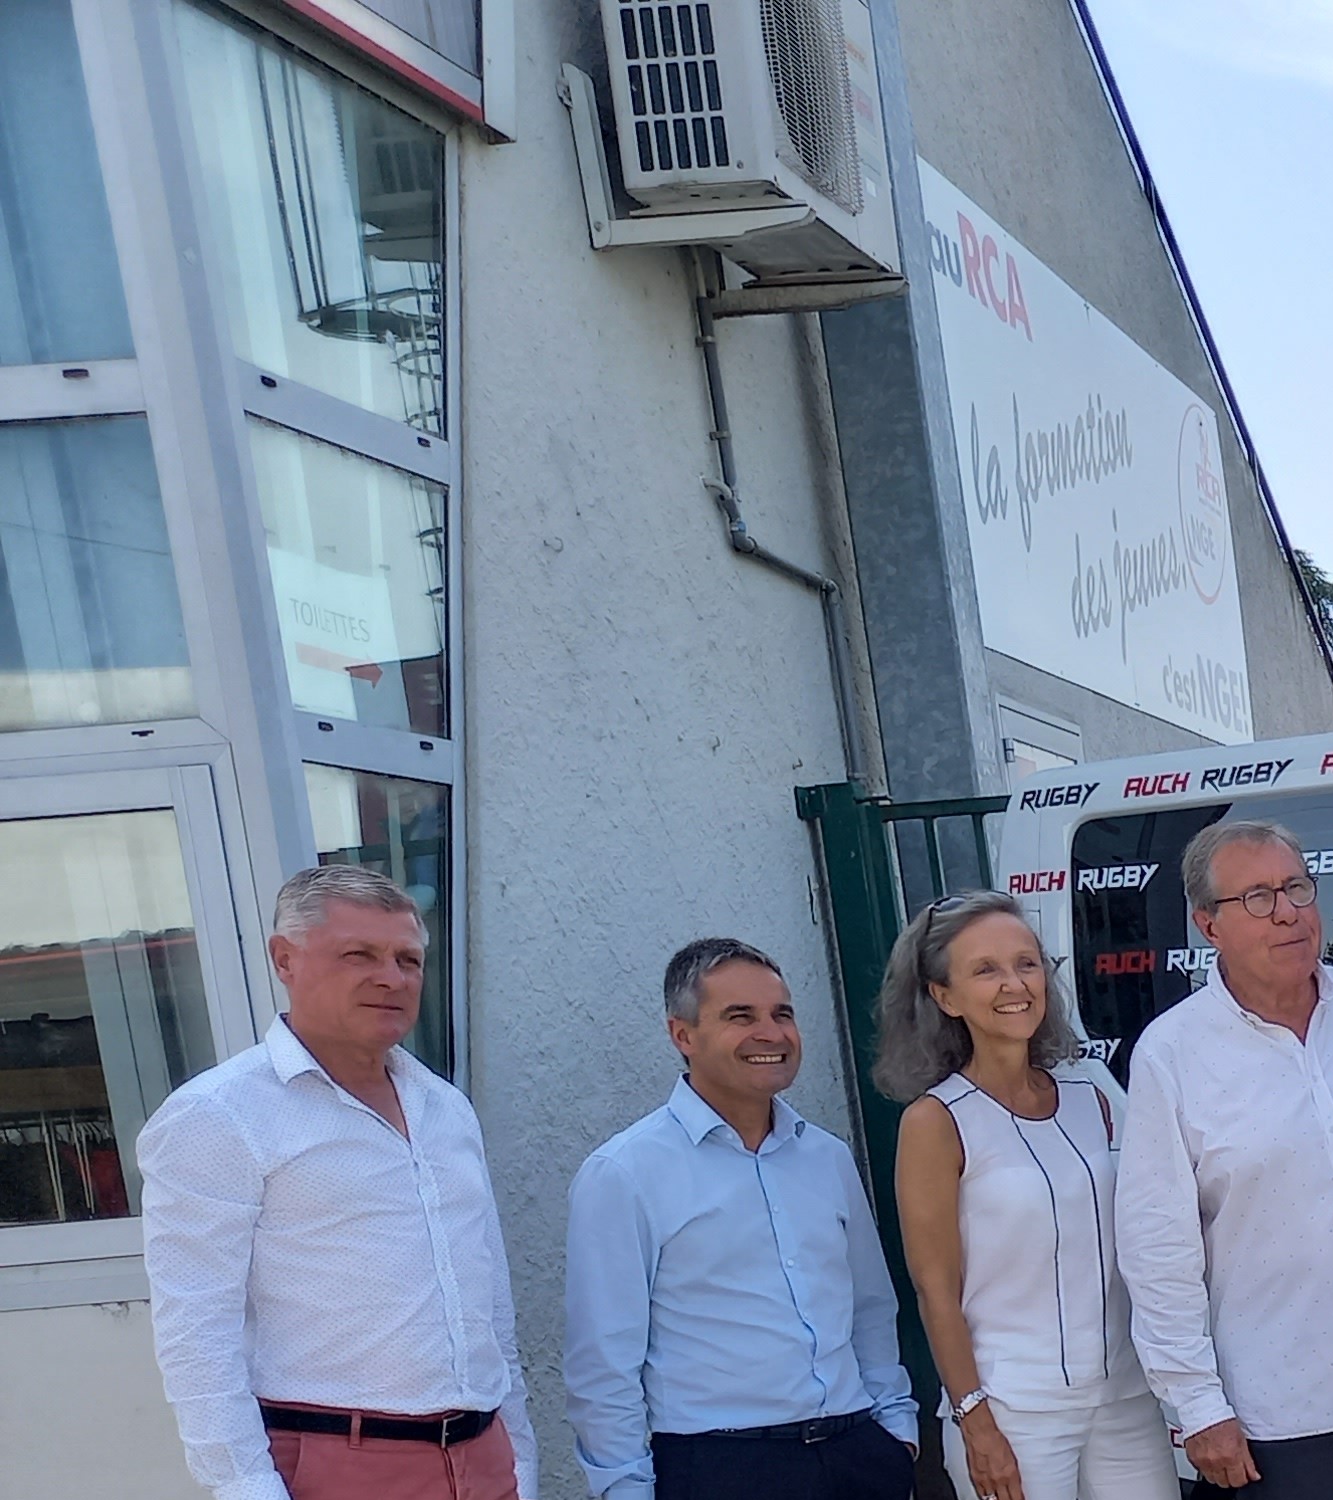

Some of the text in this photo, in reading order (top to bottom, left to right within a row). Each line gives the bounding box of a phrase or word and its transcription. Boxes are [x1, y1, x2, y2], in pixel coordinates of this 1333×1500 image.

[956, 210, 1033, 343] RCA
[971, 390, 1133, 553] la formation
[1071, 531, 1113, 638] des
[289, 598, 371, 643] TOILETTES
[1162, 652, 1249, 738] c'est NGE!
[1019, 782, 1100, 814] RUGBY
[1123, 771, 1192, 799] AUCH
[1199, 758, 1296, 793] RUGBY
[1009, 863, 1160, 896] AUCH RUGBY
[1096, 950, 1157, 976] AUCH
